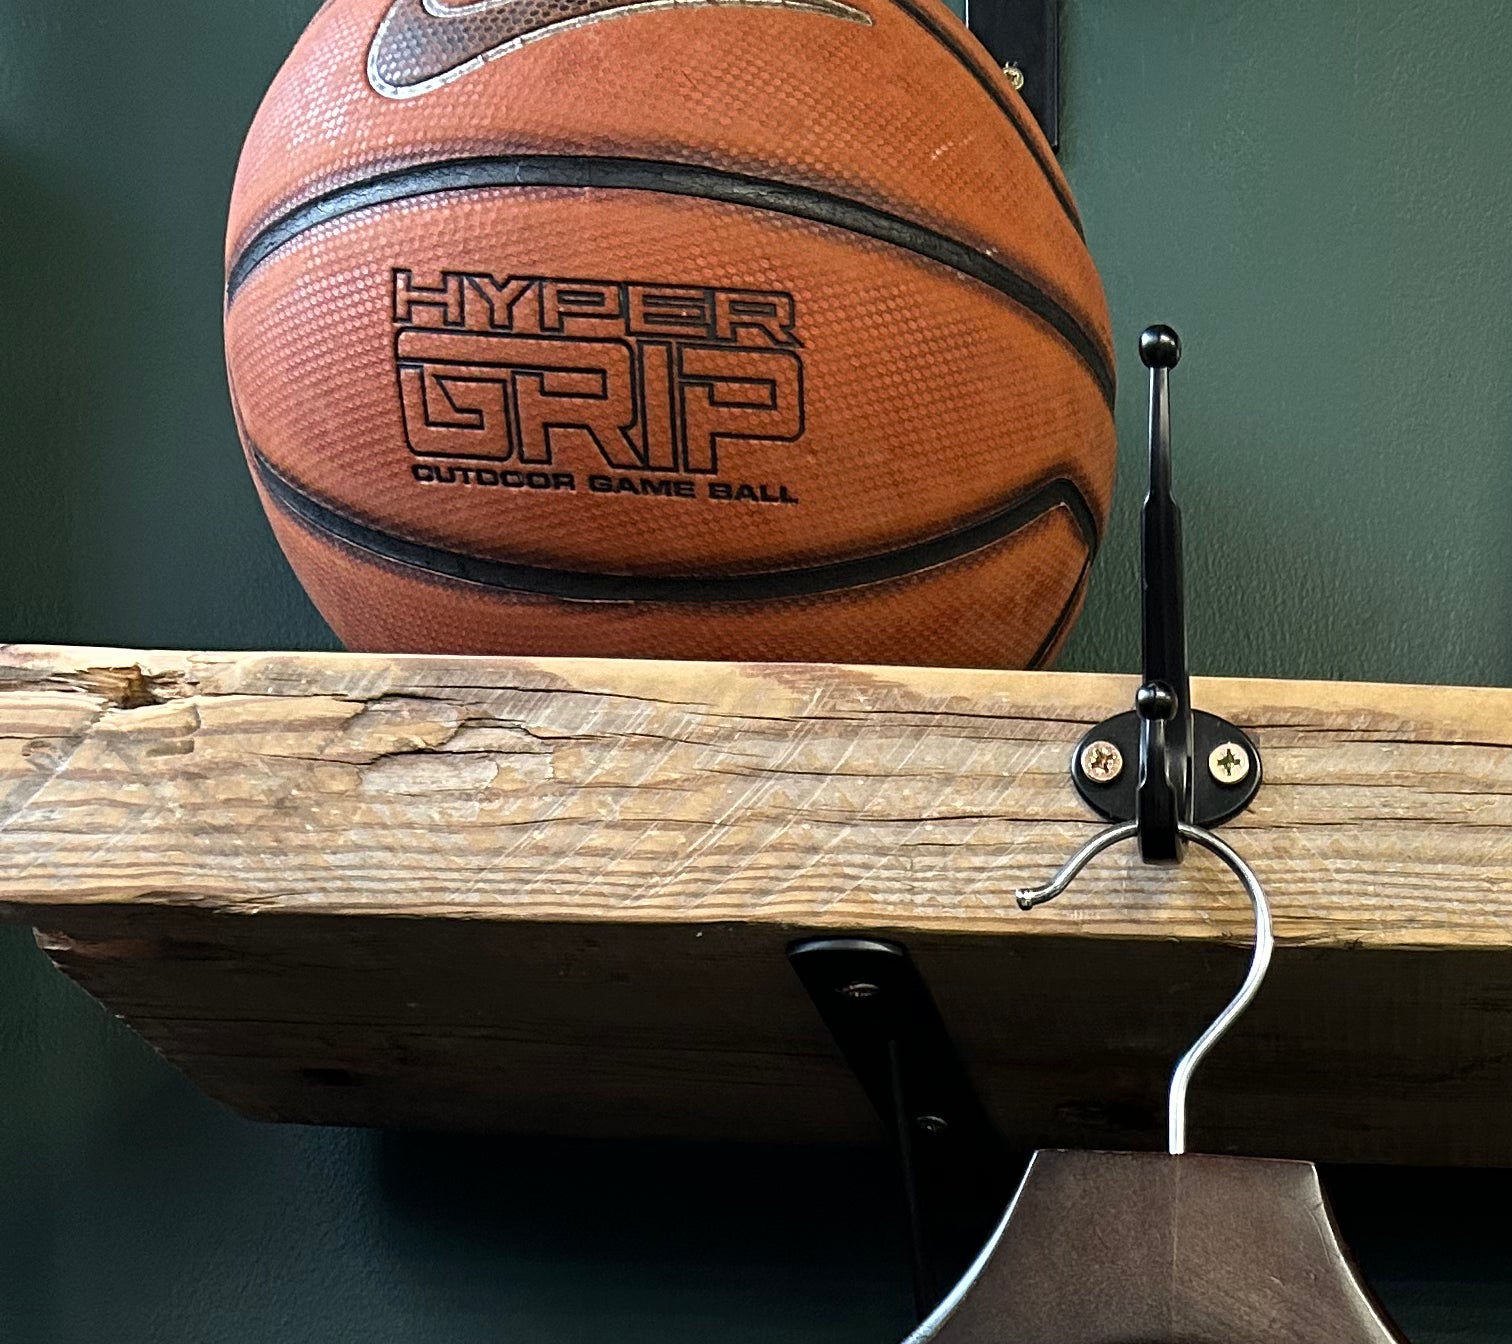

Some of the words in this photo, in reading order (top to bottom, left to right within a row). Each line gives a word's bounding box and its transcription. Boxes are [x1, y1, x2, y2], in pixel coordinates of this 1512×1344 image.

[391, 267, 804, 348] HYPER
[396, 326, 805, 475] GRIP
[411, 463, 576, 491] OUTDOOR
[588, 474, 697, 499] GAME
[708, 482, 800, 505] BALL
